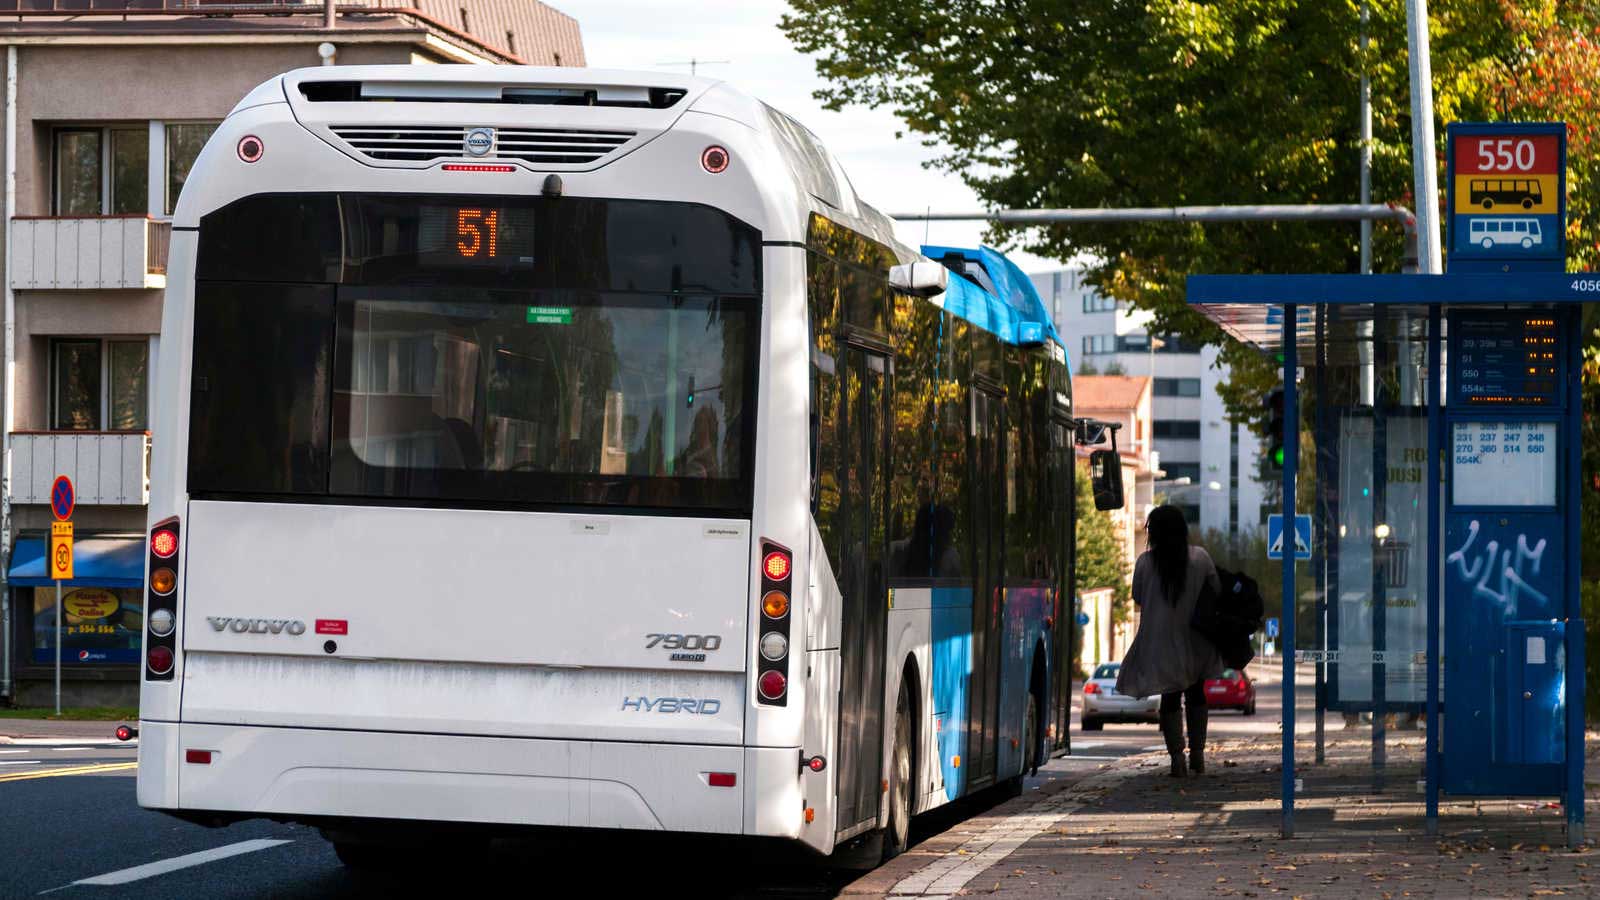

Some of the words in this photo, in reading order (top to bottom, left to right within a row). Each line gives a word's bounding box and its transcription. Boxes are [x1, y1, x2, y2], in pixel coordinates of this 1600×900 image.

[1477, 139, 1536, 171] 550
[457, 208, 498, 258] 51
[1456, 433, 1473, 442] 231
[1479, 433, 1497, 442] 237
[1503, 433, 1521, 442] 247
[1527, 433, 1545, 442] 248
[1456, 444, 1473, 453] 270
[1503, 444, 1521, 453] 514
[1456, 455, 1480, 464] 554K
[58, 550, 68, 564] 30
[206, 616, 306, 635] VOLVO
[645, 633, 722, 650] 7900
[621, 695, 721, 715] HYBRID
